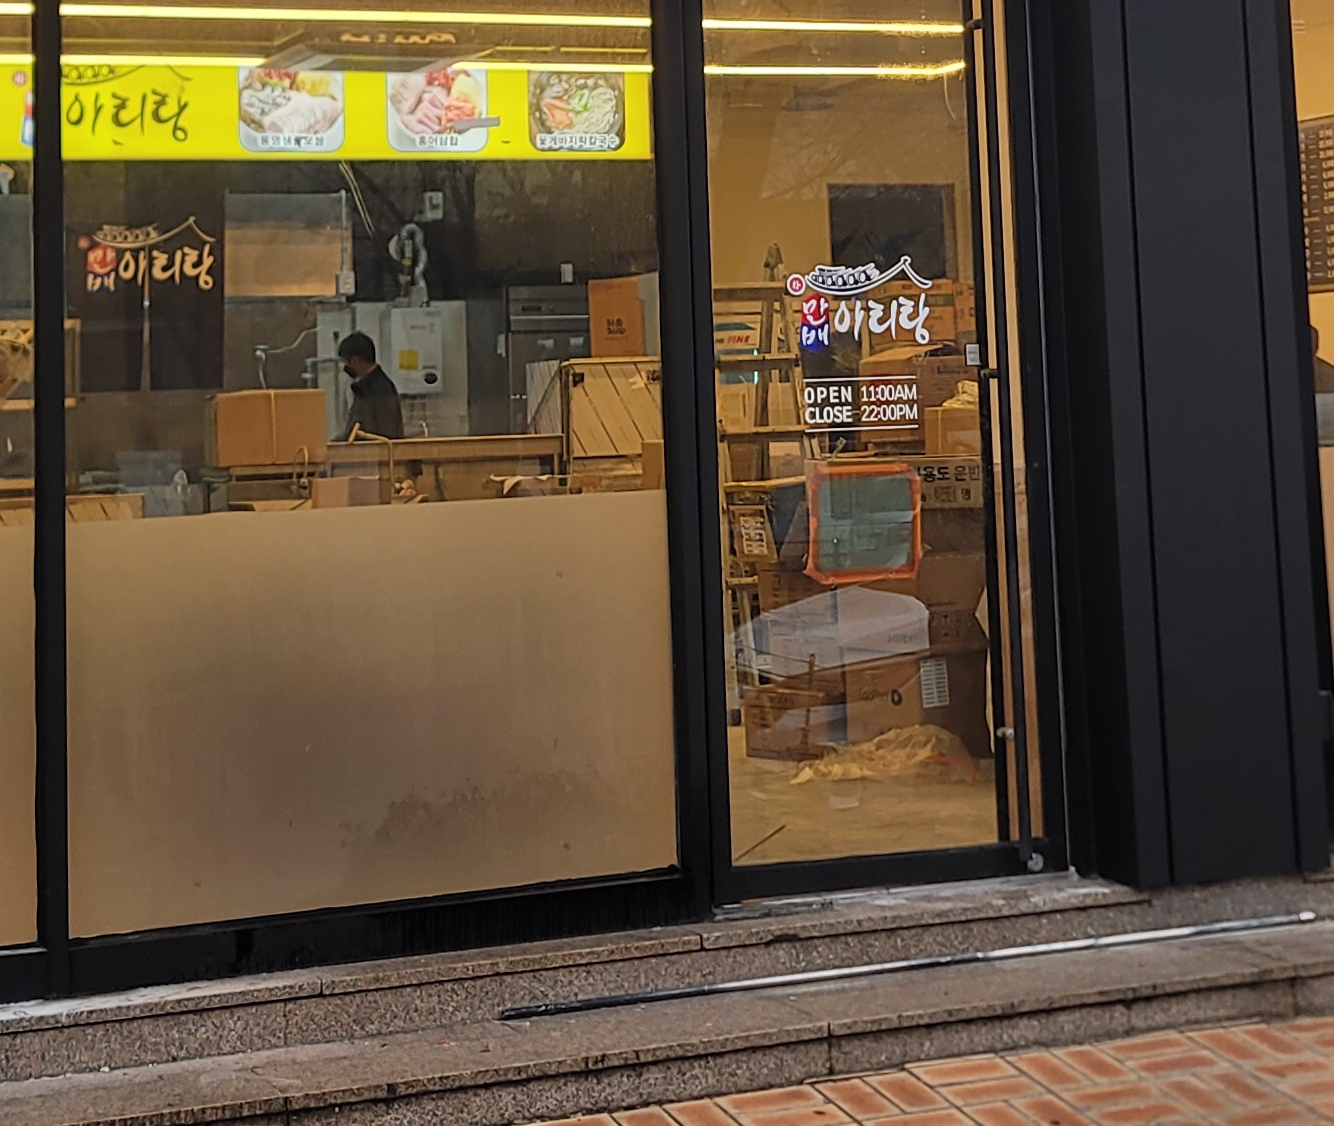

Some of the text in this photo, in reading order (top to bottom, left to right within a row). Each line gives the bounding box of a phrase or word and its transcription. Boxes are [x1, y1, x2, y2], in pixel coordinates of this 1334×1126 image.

[66, 86, 190, 142] 아리랑
[118, 243, 215, 291] 아리랑
[833, 293, 930, 345] 아리랑
[804, 384, 917, 404] OPEN 11:00AM
[804, 404, 918, 424] CLOSE 22:00PM
